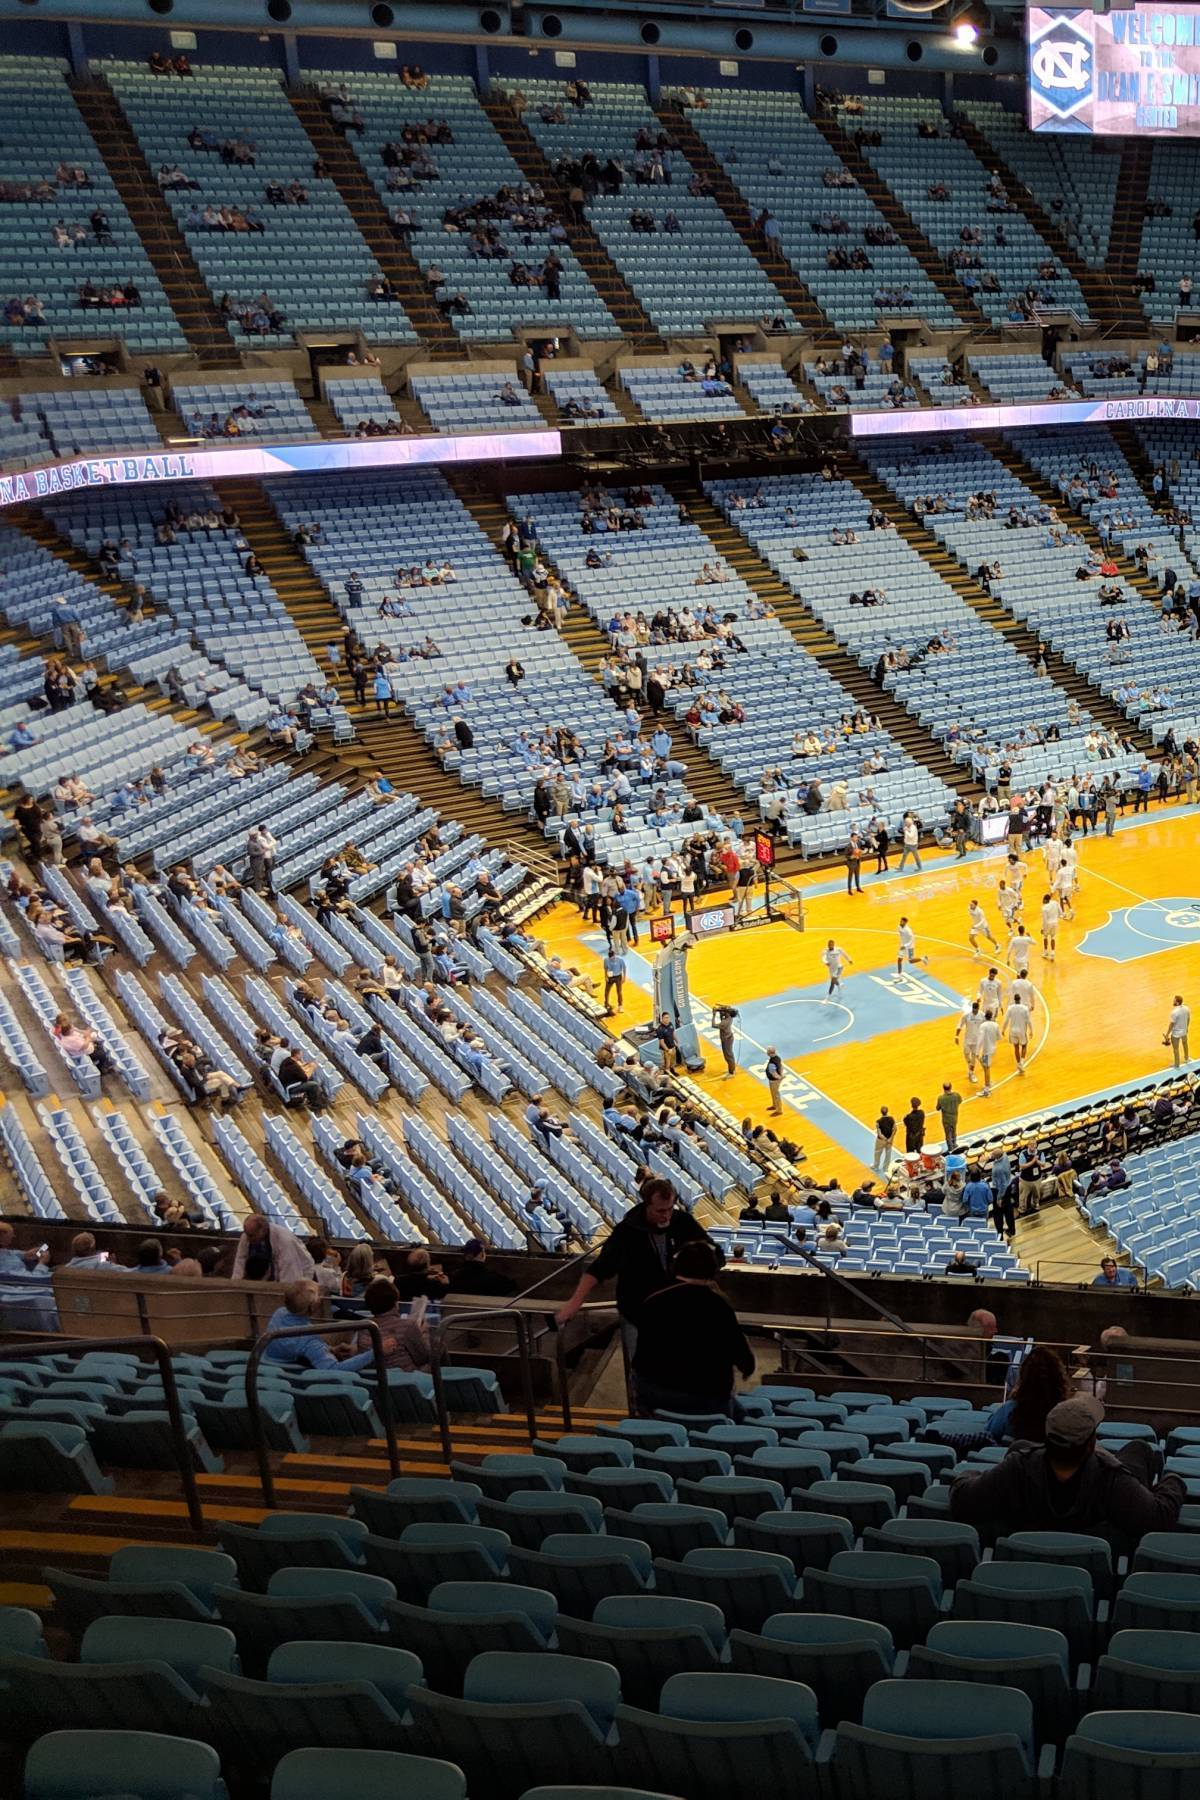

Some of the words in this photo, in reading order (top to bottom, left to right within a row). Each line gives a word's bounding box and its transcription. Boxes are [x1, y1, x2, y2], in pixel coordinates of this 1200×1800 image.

[1140, 51, 1153, 68] TO
[1156, 51, 1176, 69] THE
[1097, 71, 1140, 102] DEAN
[1135, 105, 1178, 129] CENTER
[1106, 400, 1188, 419] CAROLINA
[35, 455, 195, 498] BASKETBALL
